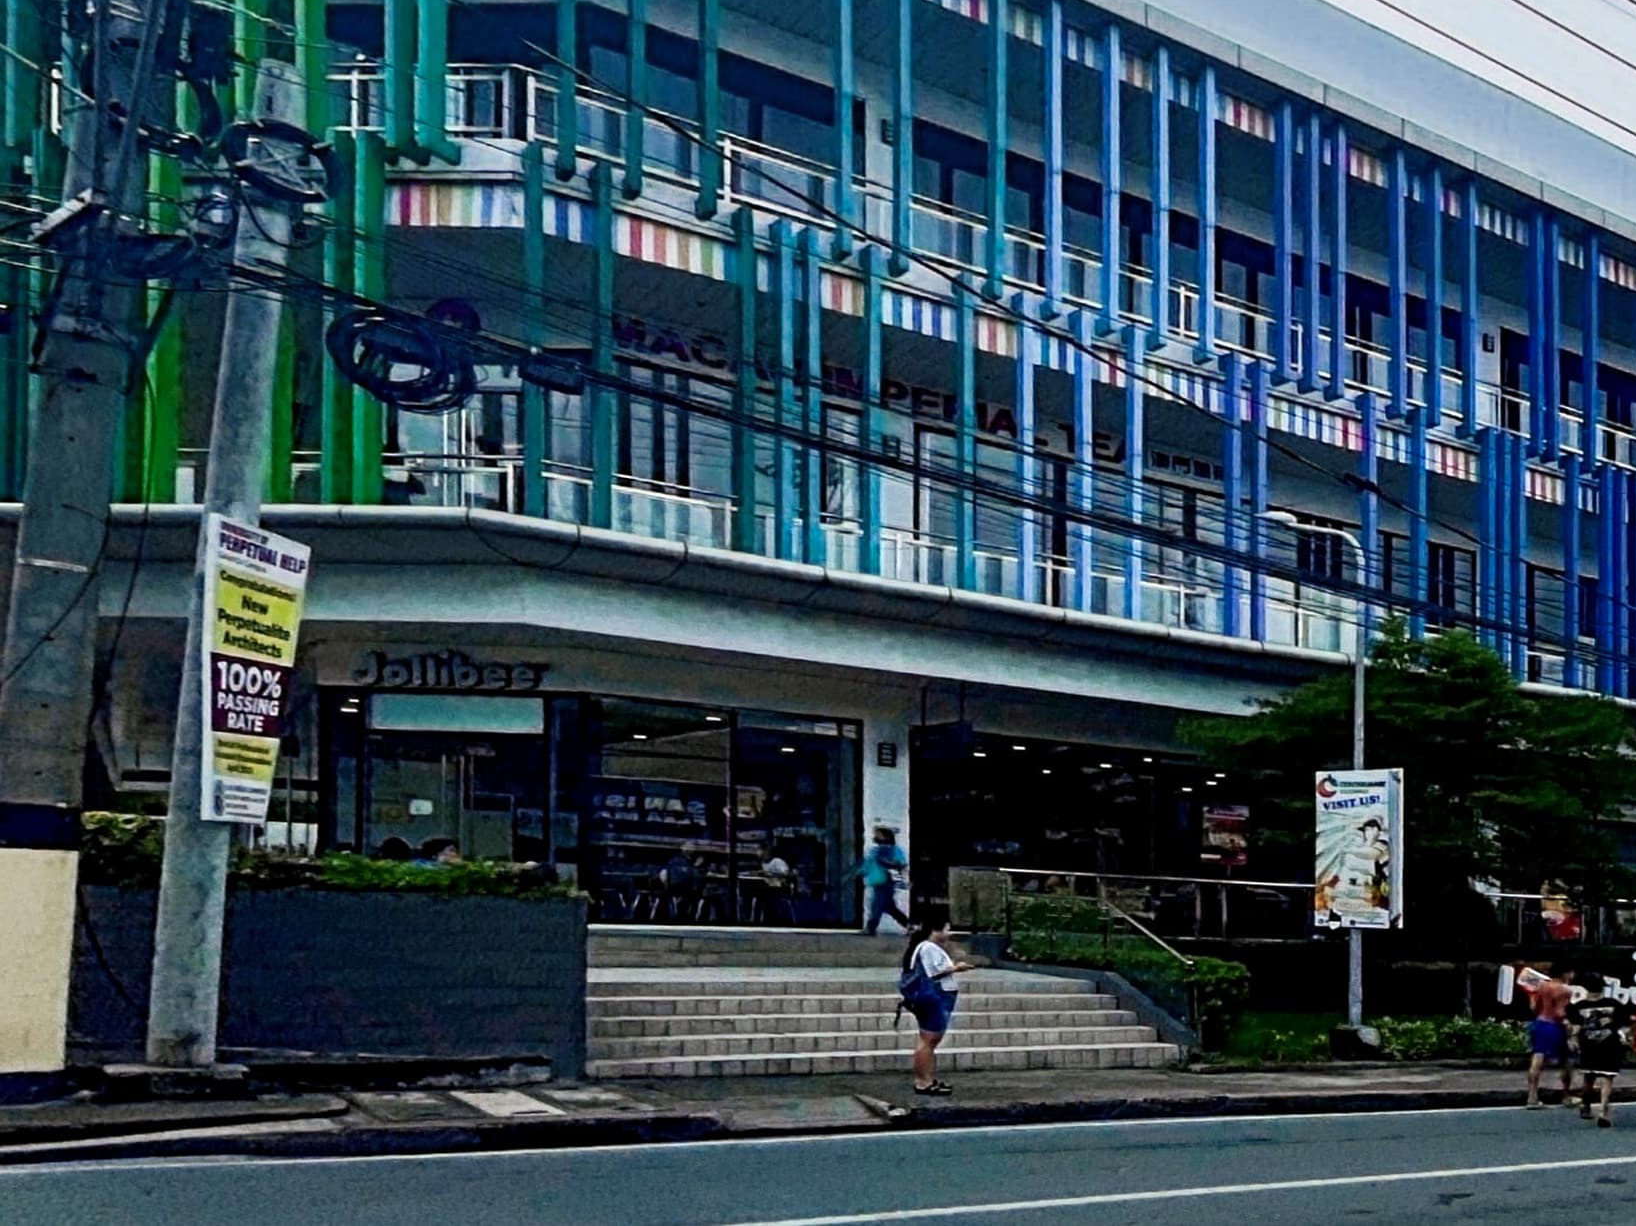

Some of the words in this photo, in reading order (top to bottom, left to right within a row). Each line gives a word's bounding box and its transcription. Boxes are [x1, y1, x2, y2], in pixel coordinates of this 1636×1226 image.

[823, 362, 1049, 447] IMPEIA
[219, 532, 278, 566] PERPETUAL
[280, 552, 306, 574] HELP
[241, 595, 269, 615] New
[217, 608, 290, 641] Perpetualite
[222, 631, 283, 658] Architects
[216, 660, 282, 698] 100%
[353, 647, 545, 689] Jollibee
[217, 691, 280, 716] PASSING
[227, 712, 264, 732] RATE
[1322, 798, 1357, 811] VISIT
